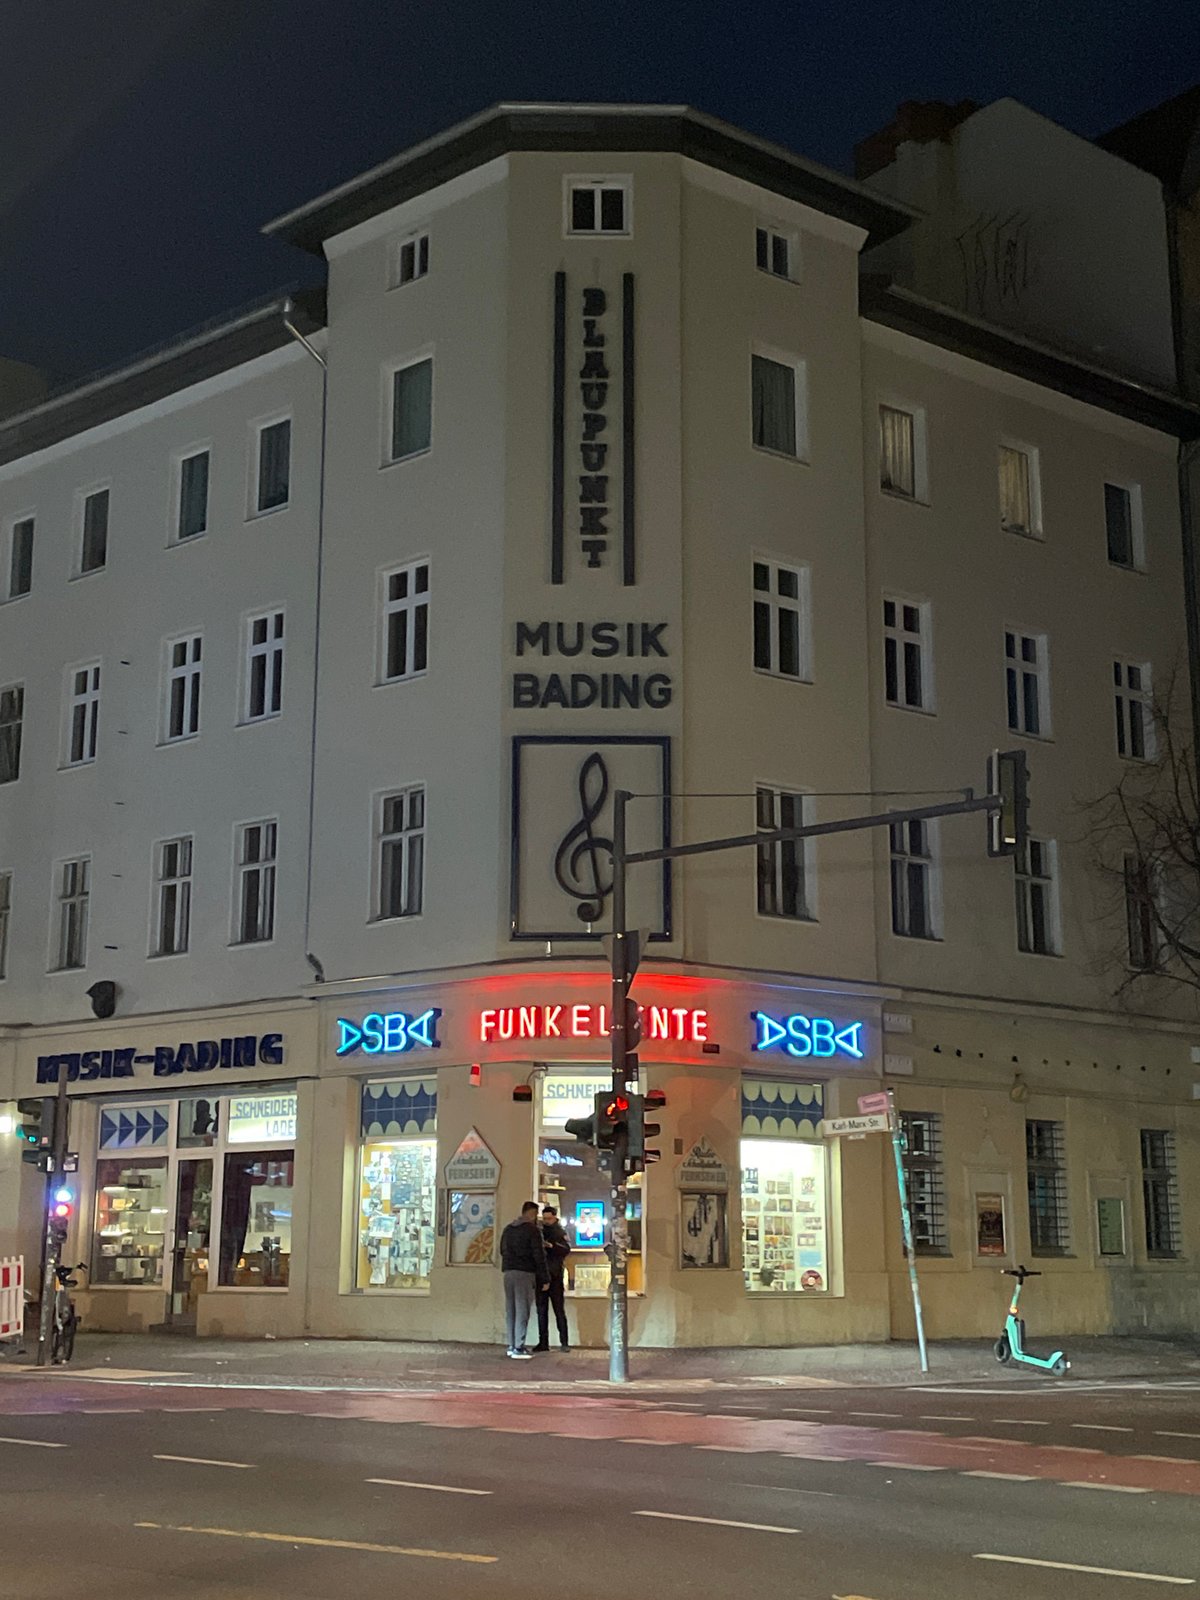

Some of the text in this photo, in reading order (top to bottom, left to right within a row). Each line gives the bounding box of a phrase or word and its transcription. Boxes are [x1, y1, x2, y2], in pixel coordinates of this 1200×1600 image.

[579, 287, 609, 568] BLAUPUNKT
[515, 621, 669, 658] MUSIK
[512, 673, 673, 709] BADING
[480, 1004, 708, 1043] FUNKELNTE
[235, 1098, 297, 1118] SCHNEIDER
